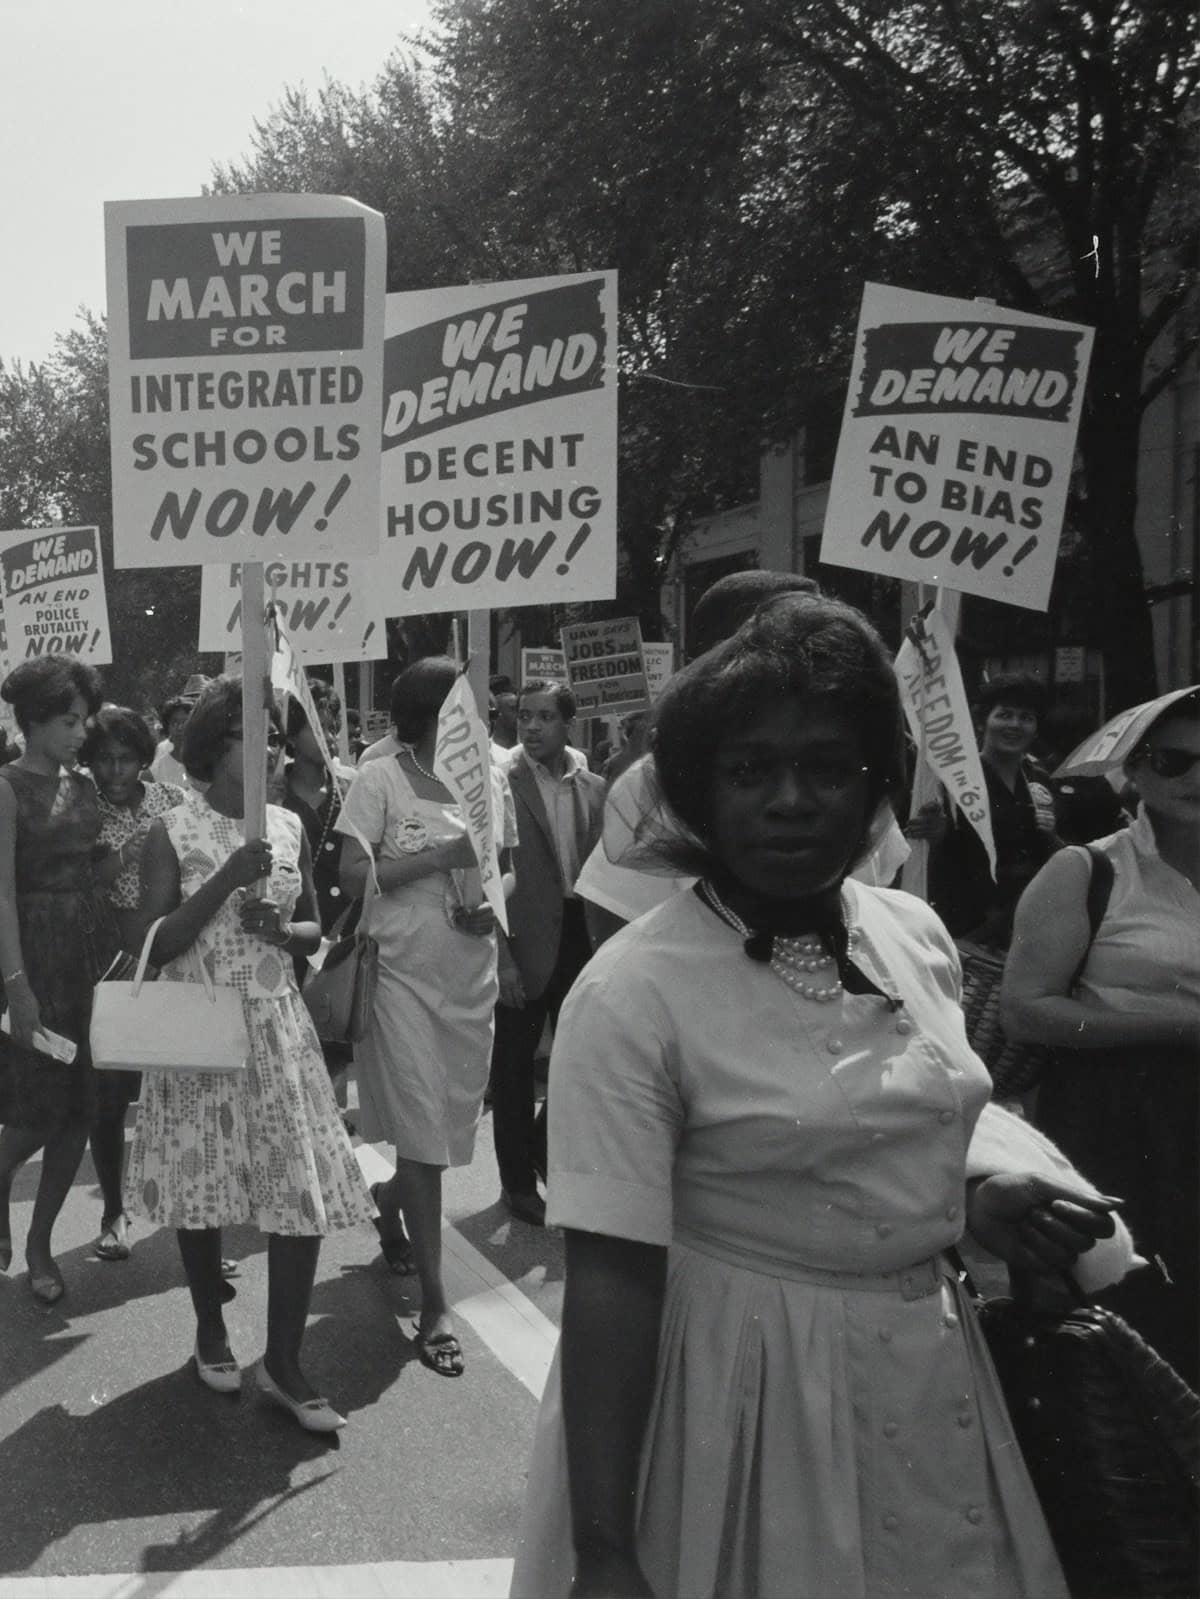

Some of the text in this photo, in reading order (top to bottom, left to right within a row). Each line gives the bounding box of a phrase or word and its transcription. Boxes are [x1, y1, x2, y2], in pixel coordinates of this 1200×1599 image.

[212, 230, 282, 265] WE
[146, 270, 347, 321] MARCH
[210, 324, 287, 348] FOR
[441, 303, 529, 368] WE
[932, 326, 1016, 364] WE
[130, 365, 364, 414] INTEGRATED
[383, 332, 598, 437] DEMAND
[869, 366, 1069, 408] DEMAND
[132, 424, 361, 471] SCHOOLS
[404, 433, 585, 484] DECENT
[869, 425, 1053, 488] AN END
[150, 473, 352, 542] NOW!
[387, 486, 602, 537] HOUSING
[870, 465, 1043, 530] TO BIAS
[32, 535, 67, 561] WE
[402, 522, 592, 591] NOW!
[860, 509, 1039, 577] NOW!
[10, 548, 94, 591] DEMAND
[229, 561, 350, 588] RGHTS
[18, 588, 90, 606] AN END
[35, 607, 80, 622] POLICE
[226, 591, 353, 633] W!
[23, 620, 89, 636] BRUTALITY
[24, 627, 101, 658] NOW!
[568, 639, 616, 661] JOBS
[569, 657, 642, 682] FREEDOM
[437, 703, 489, 835] FREEDOM
